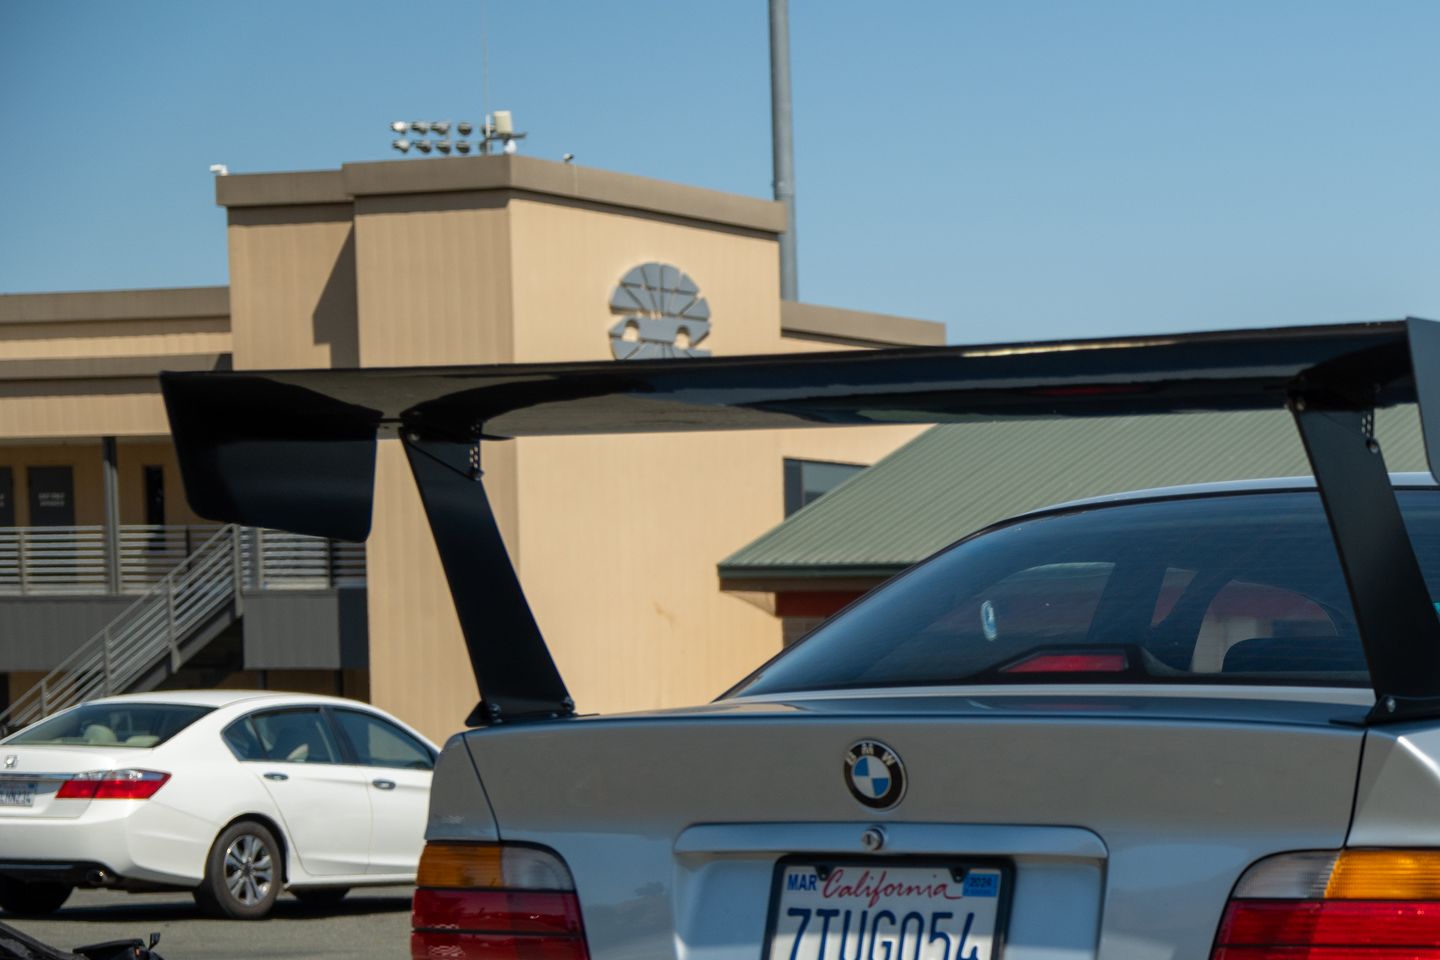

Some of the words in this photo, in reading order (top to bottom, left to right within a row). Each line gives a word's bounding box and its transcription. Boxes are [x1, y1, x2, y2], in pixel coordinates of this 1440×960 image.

[845, 743, 896, 766] BMW
[787, 873, 818, 891] MAR
[822, 869, 963, 909] California
